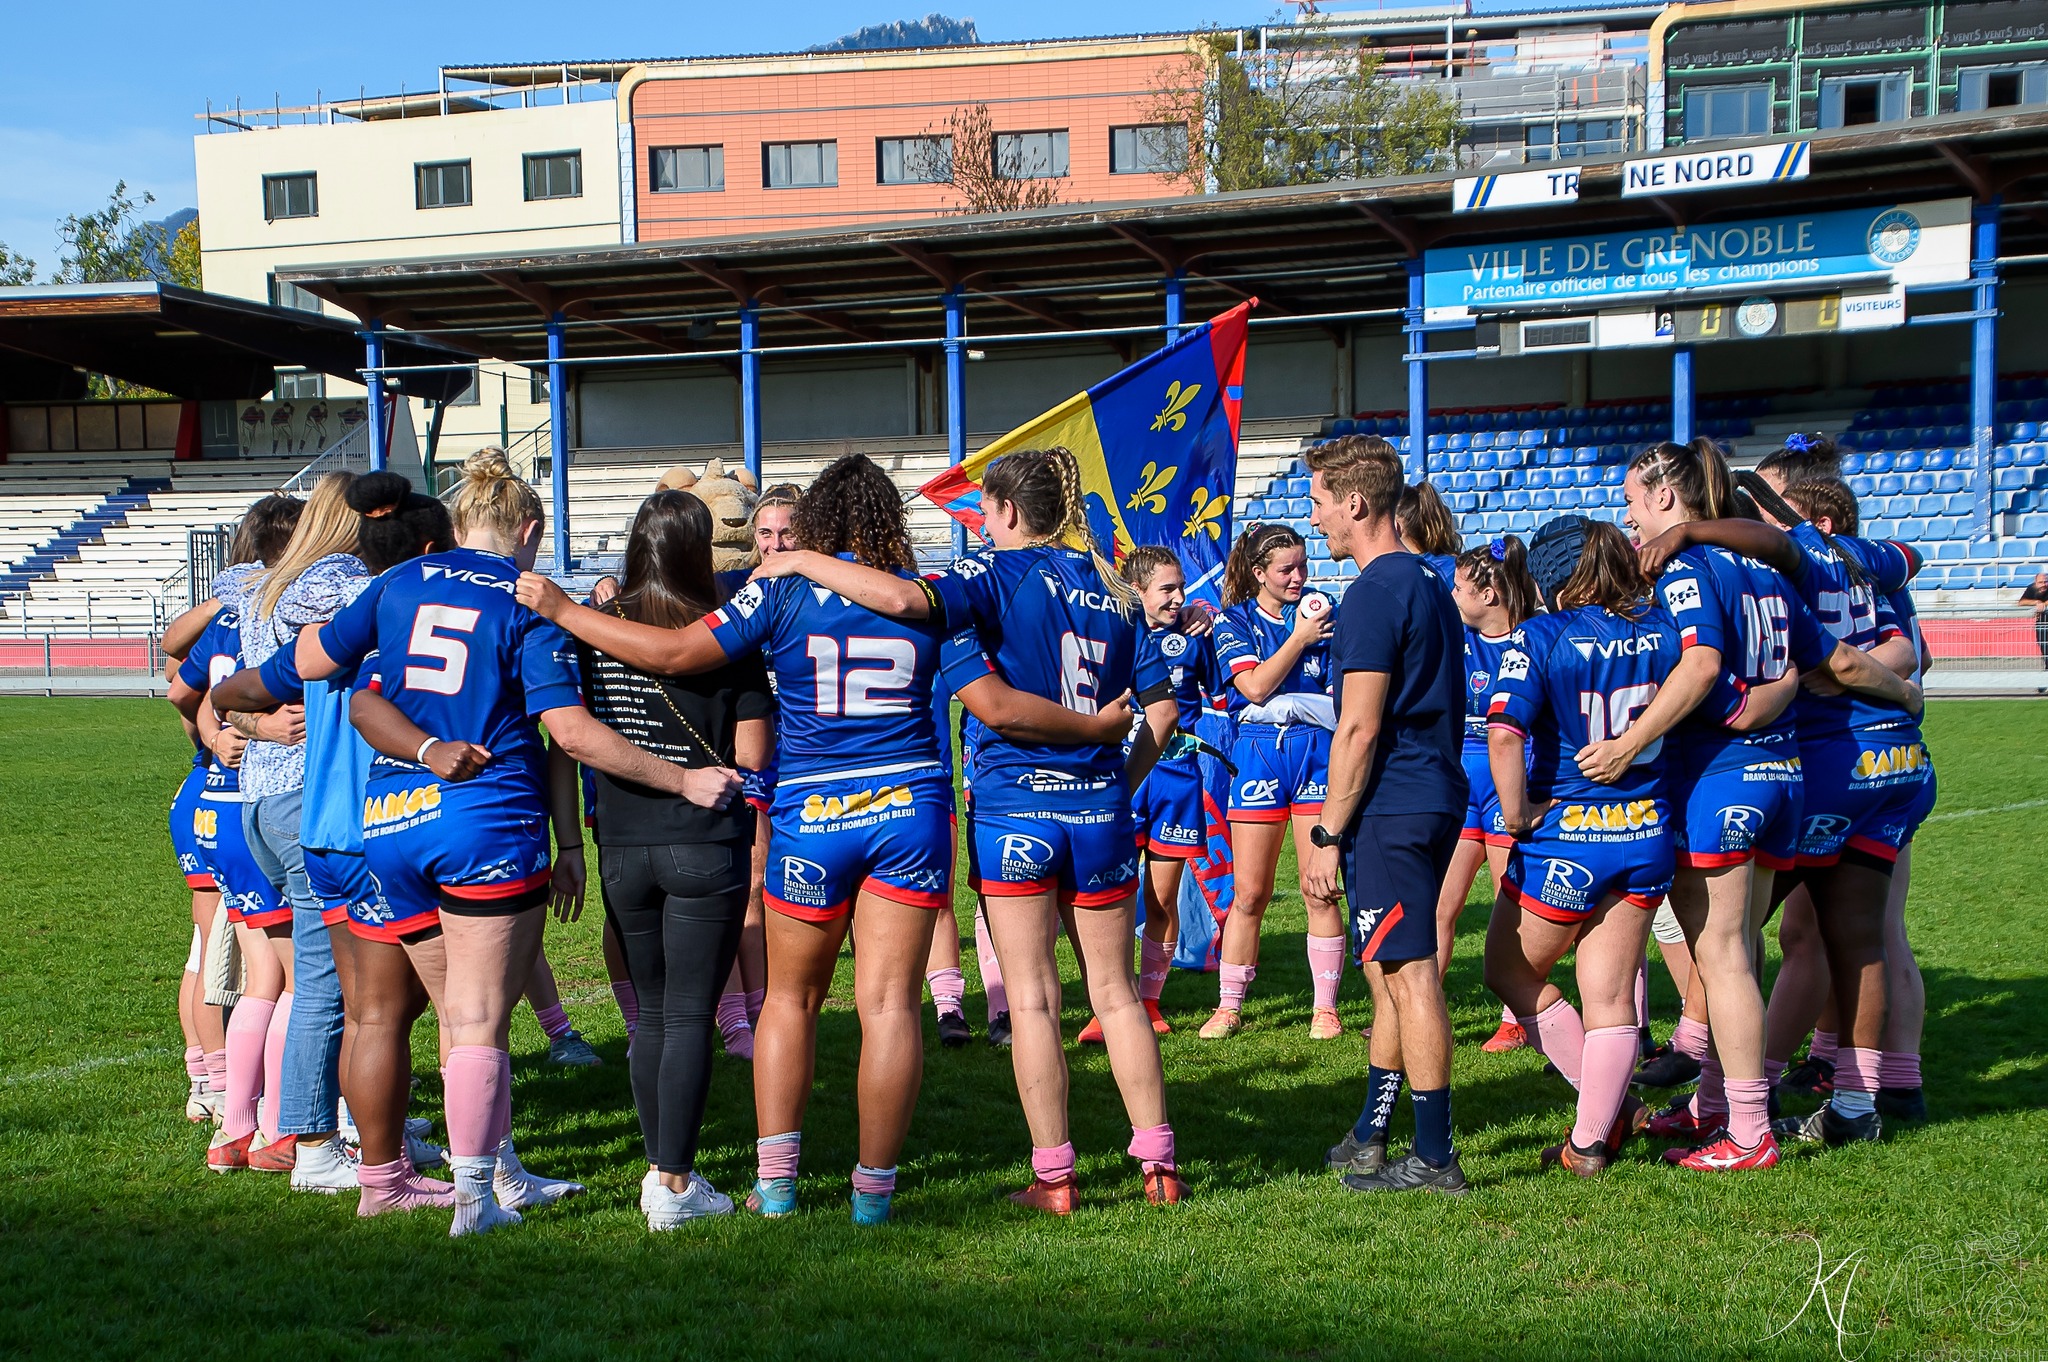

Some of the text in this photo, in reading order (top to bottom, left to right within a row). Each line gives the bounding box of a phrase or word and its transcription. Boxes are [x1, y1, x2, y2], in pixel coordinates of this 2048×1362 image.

[1669, 53, 1690, 64] ENTS
[1629, 162, 1665, 189] NE
[1675, 153, 1754, 184] NORD
[1468, 221, 1816, 282] VILLE DE GRENOBLE
[1463, 256, 1820, 301] Partenaire officiel de tous les champions
[1845, 299, 1902, 313] VISITEURS
[444, 568, 516, 595] VICA
[1067, 588, 1124, 614] VICAT
[404, 604, 482, 696] 5
[1596, 633, 1662, 659] VICAT
[806, 634, 917, 717] 12
[800, 784, 914, 823] SAMSE
[1559, 800, 1658, 832] SAMSE
[799, 807, 916, 834] BRAVO, LES HOMMES EN BLEU!
[1038, 811, 1051, 819] LES
[1052, 812, 1084, 824] HOMMES
[1085, 814, 1095, 824] EN
[1096, 812, 1115, 823] BLEU!
[1161, 821, 1198, 839] isère
[1559, 832, 1587, 843] BRAVO,
[1588, 833, 1601, 842] LES
[1602, 832, 1634, 843] HOMMES
[1636, 831, 1645, 841] EN
[784, 878, 826, 891] RIONDET
[784, 886, 826, 897] ENTREPRISES
[1544, 879, 1589, 898] RIONDET
[784, 893, 827, 906] SERIPUB
[1541, 893, 1586, 911] SERIPUB
